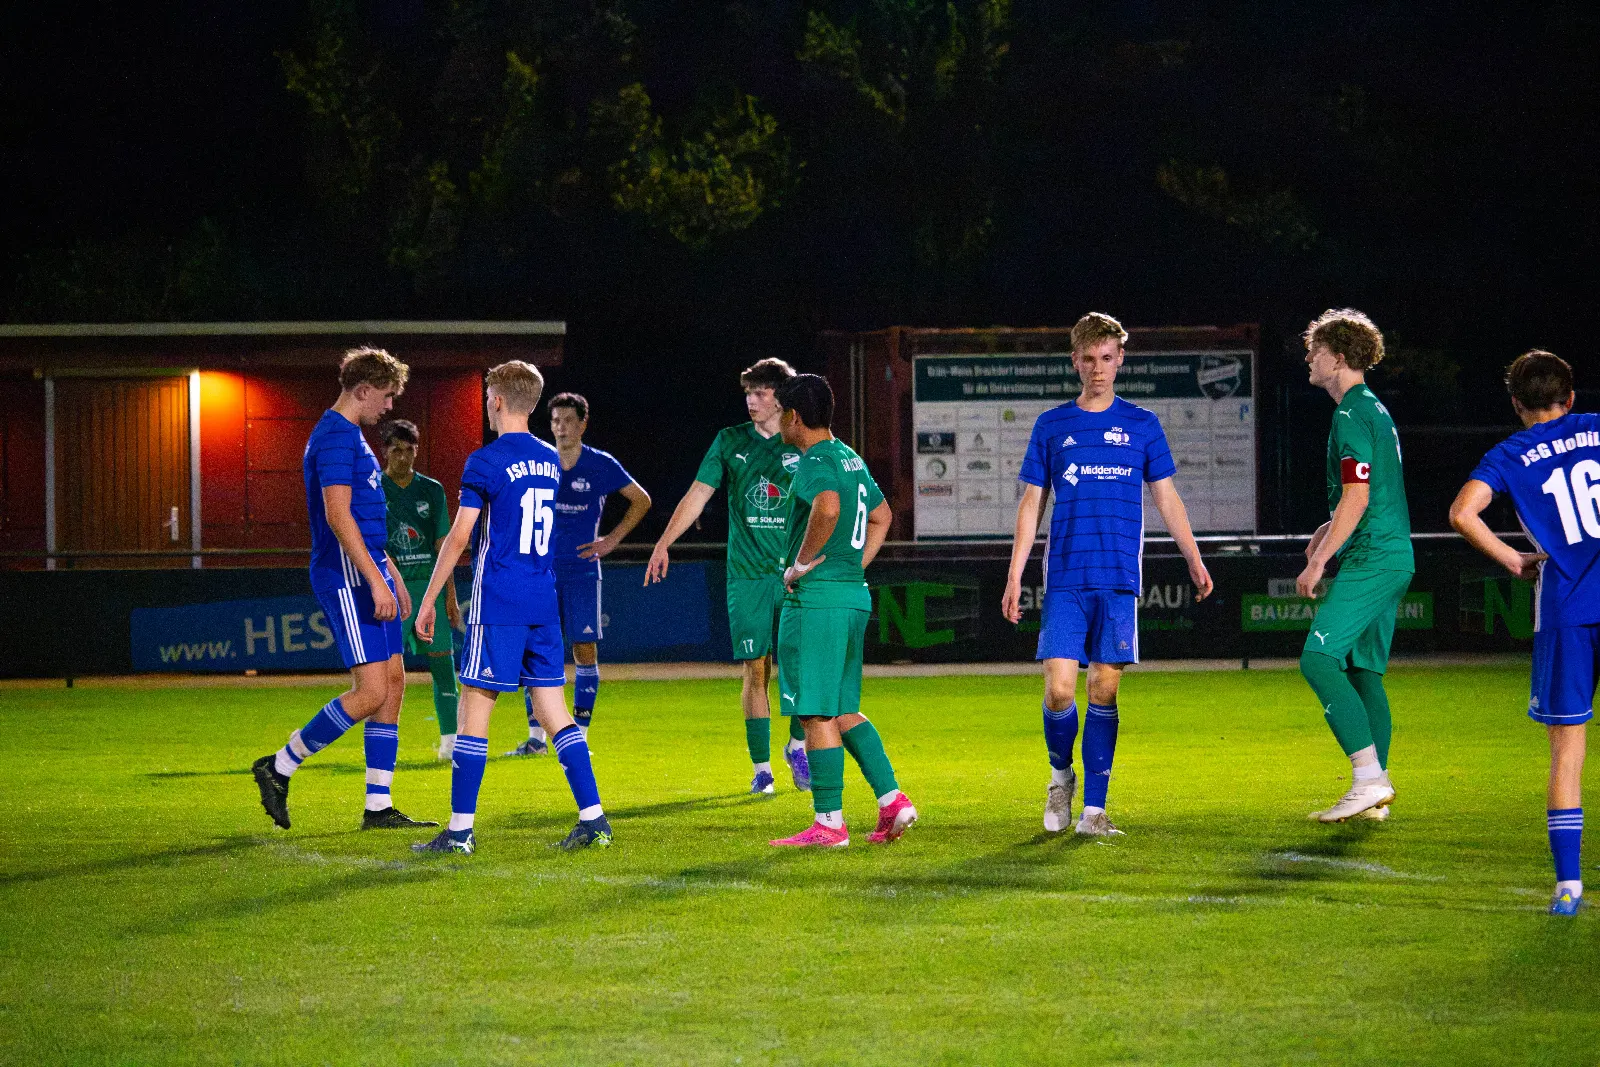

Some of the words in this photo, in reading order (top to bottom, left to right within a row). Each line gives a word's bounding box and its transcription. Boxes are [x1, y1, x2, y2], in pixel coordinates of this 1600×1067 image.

[1520, 443, 1552, 467] JSG
[506, 461, 528, 482] JSG
[1080, 465, 1133, 477] Middendorf
[1355, 462, 1371, 480] C
[1541, 459, 1600, 546] 16
[519, 487, 555, 557] 15
[850, 482, 868, 550] 6
[742, 638, 754, 654] 17
